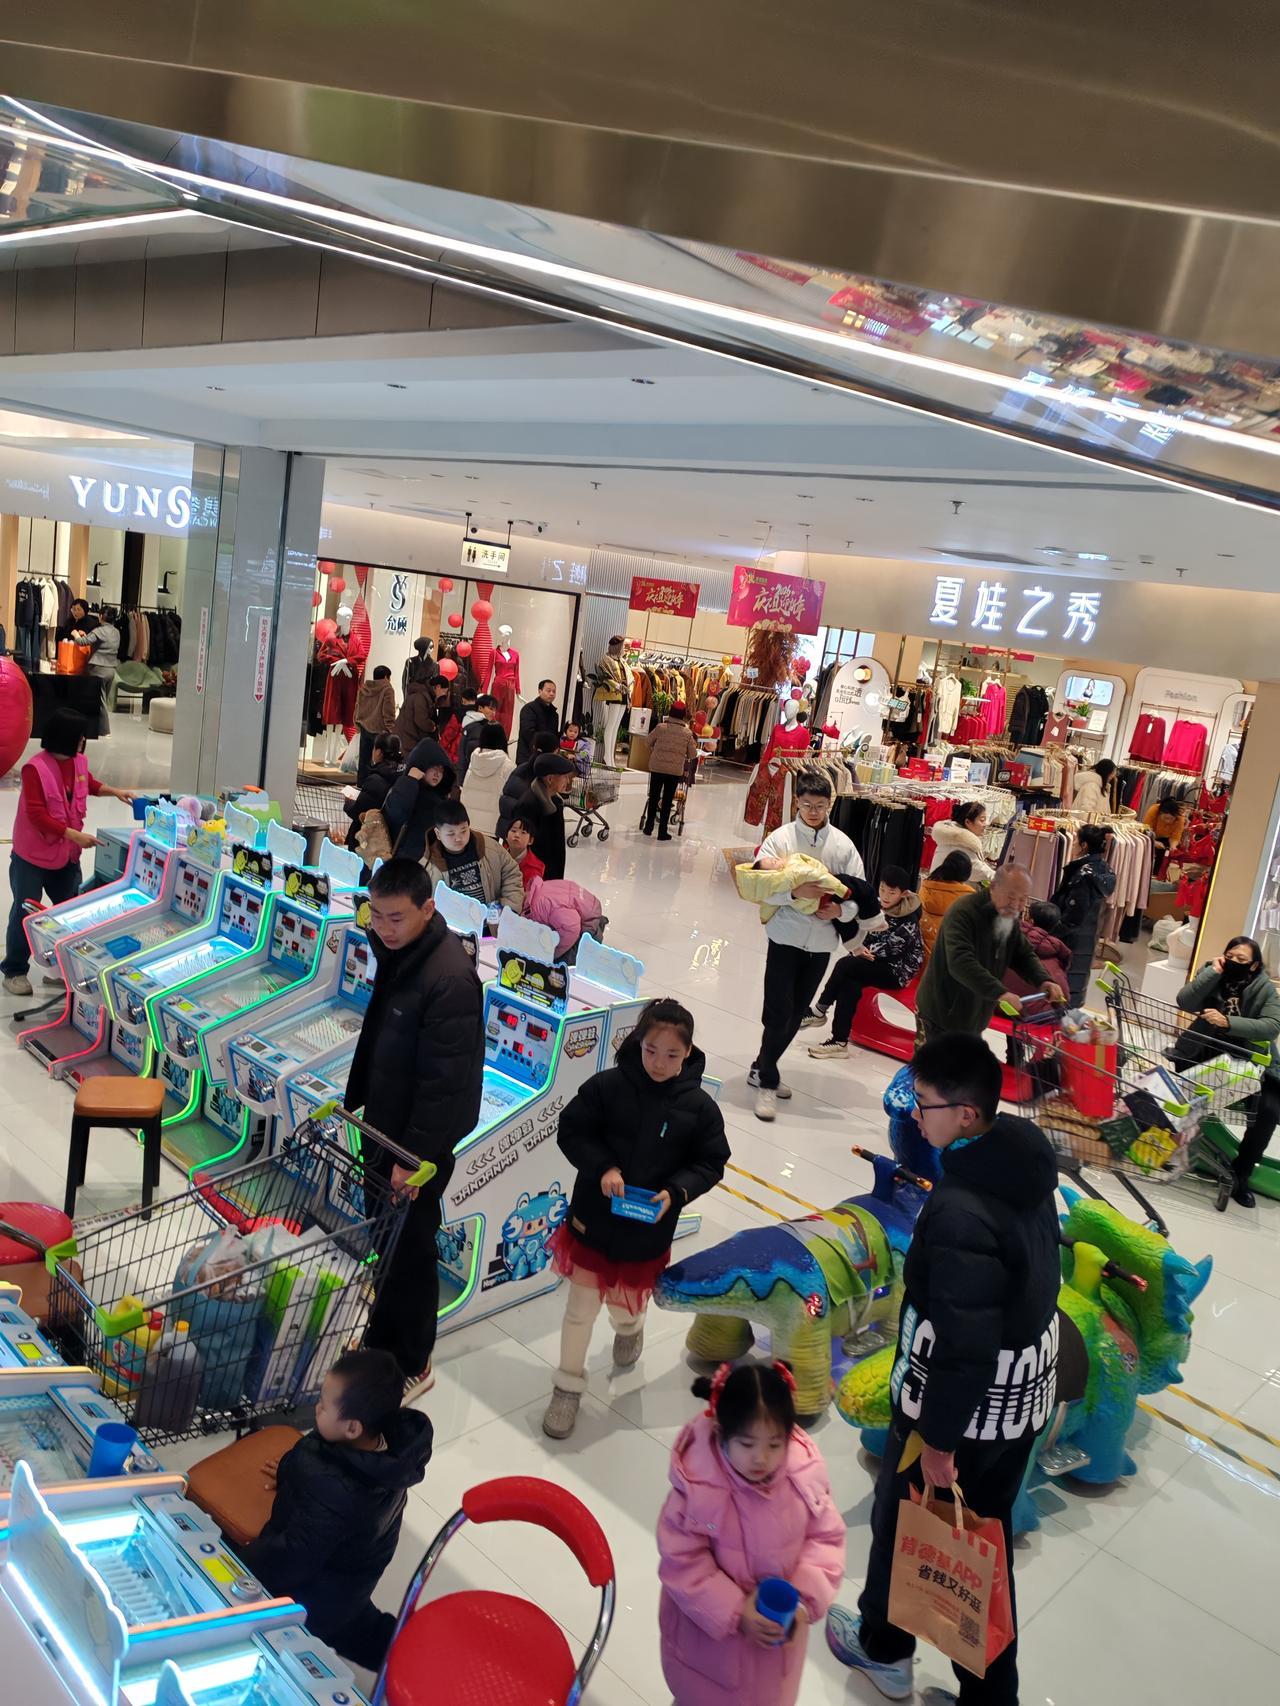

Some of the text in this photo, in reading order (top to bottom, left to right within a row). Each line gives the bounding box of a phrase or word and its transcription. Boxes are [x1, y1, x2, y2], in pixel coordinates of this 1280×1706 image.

[481, 549, 506, 562] 洗手间
[929, 575, 1102, 643] 夏娃之秀
[1165, 689, 1197, 702] Fashion
[901, 1535, 983, 1591] 肯德基APP
